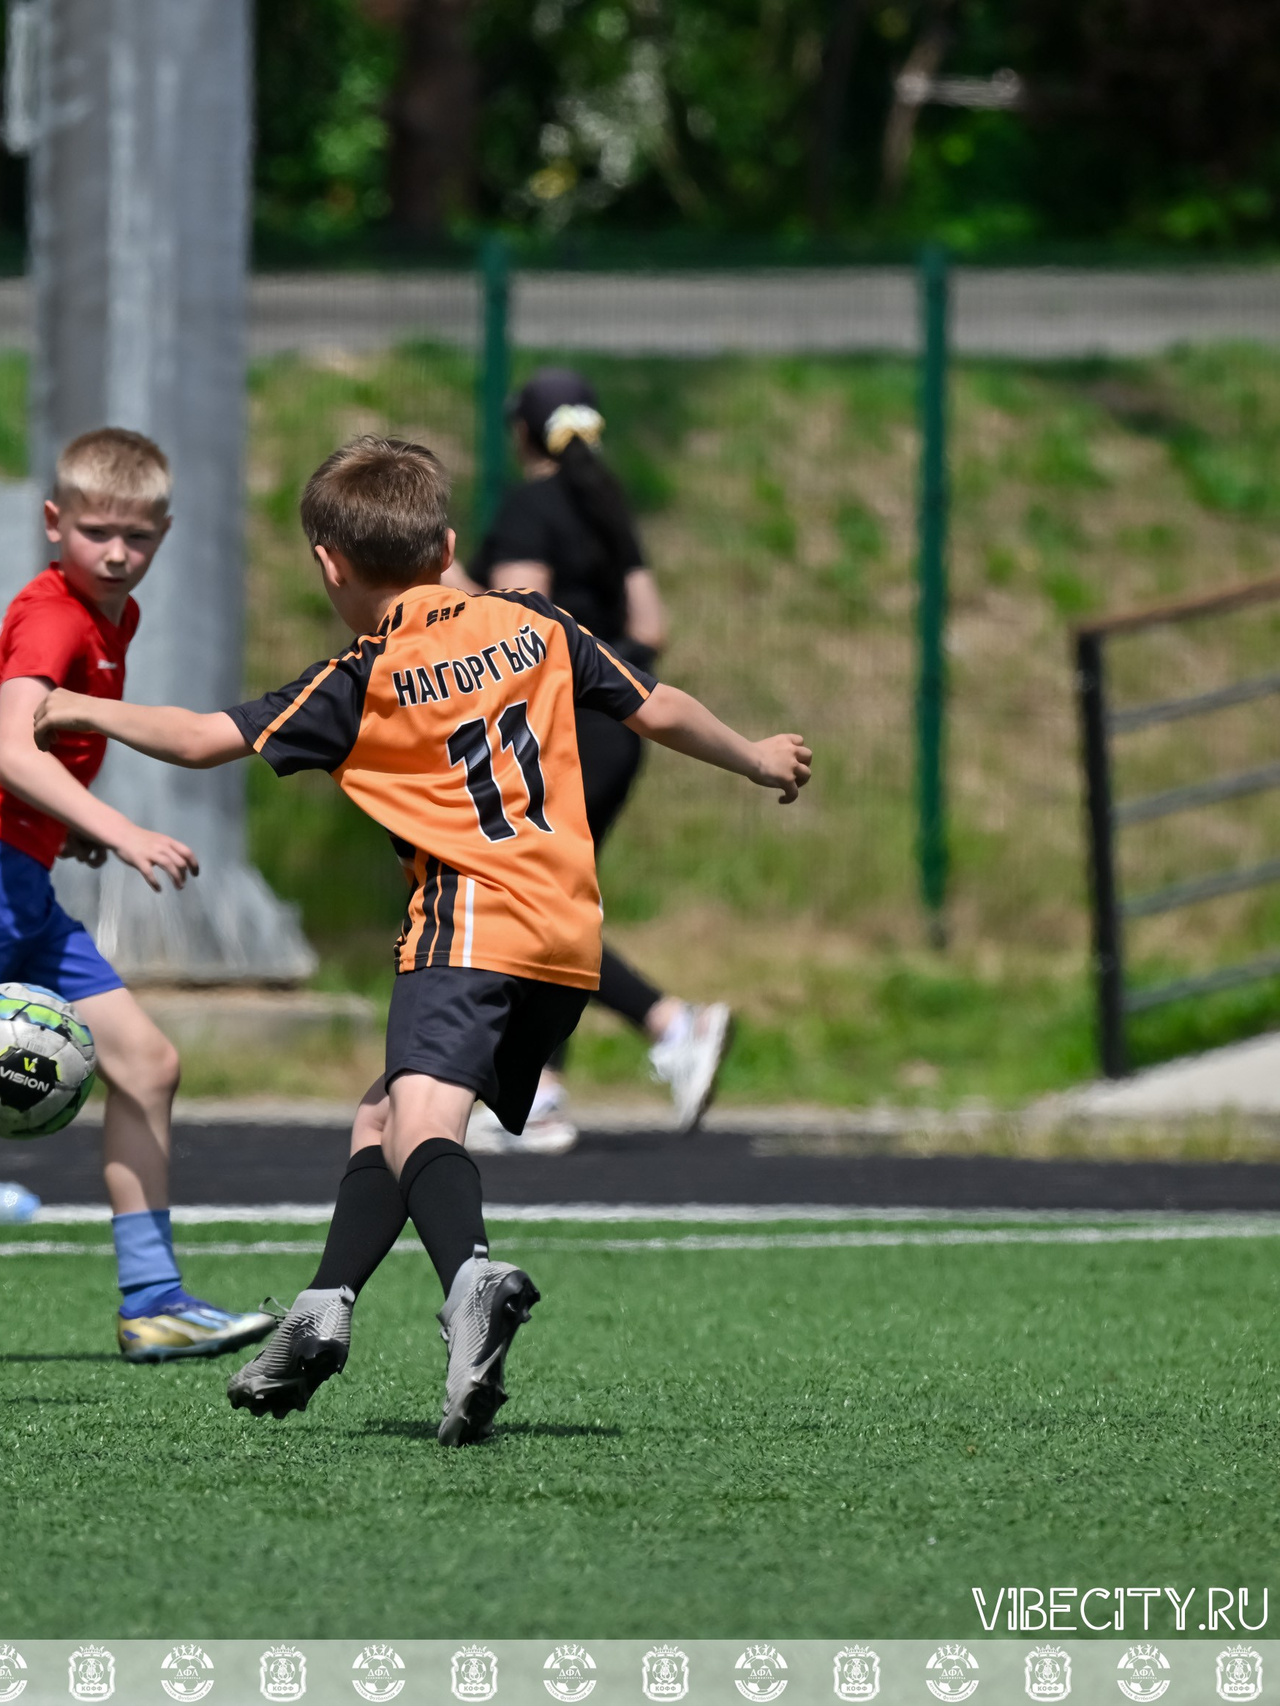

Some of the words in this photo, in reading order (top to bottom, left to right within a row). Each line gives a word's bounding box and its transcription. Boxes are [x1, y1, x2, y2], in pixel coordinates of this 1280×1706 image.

[391, 623, 548, 708] НАГОРГЫЙ
[446, 699, 555, 843] 11
[0, 1066, 50, 1093] VISION
